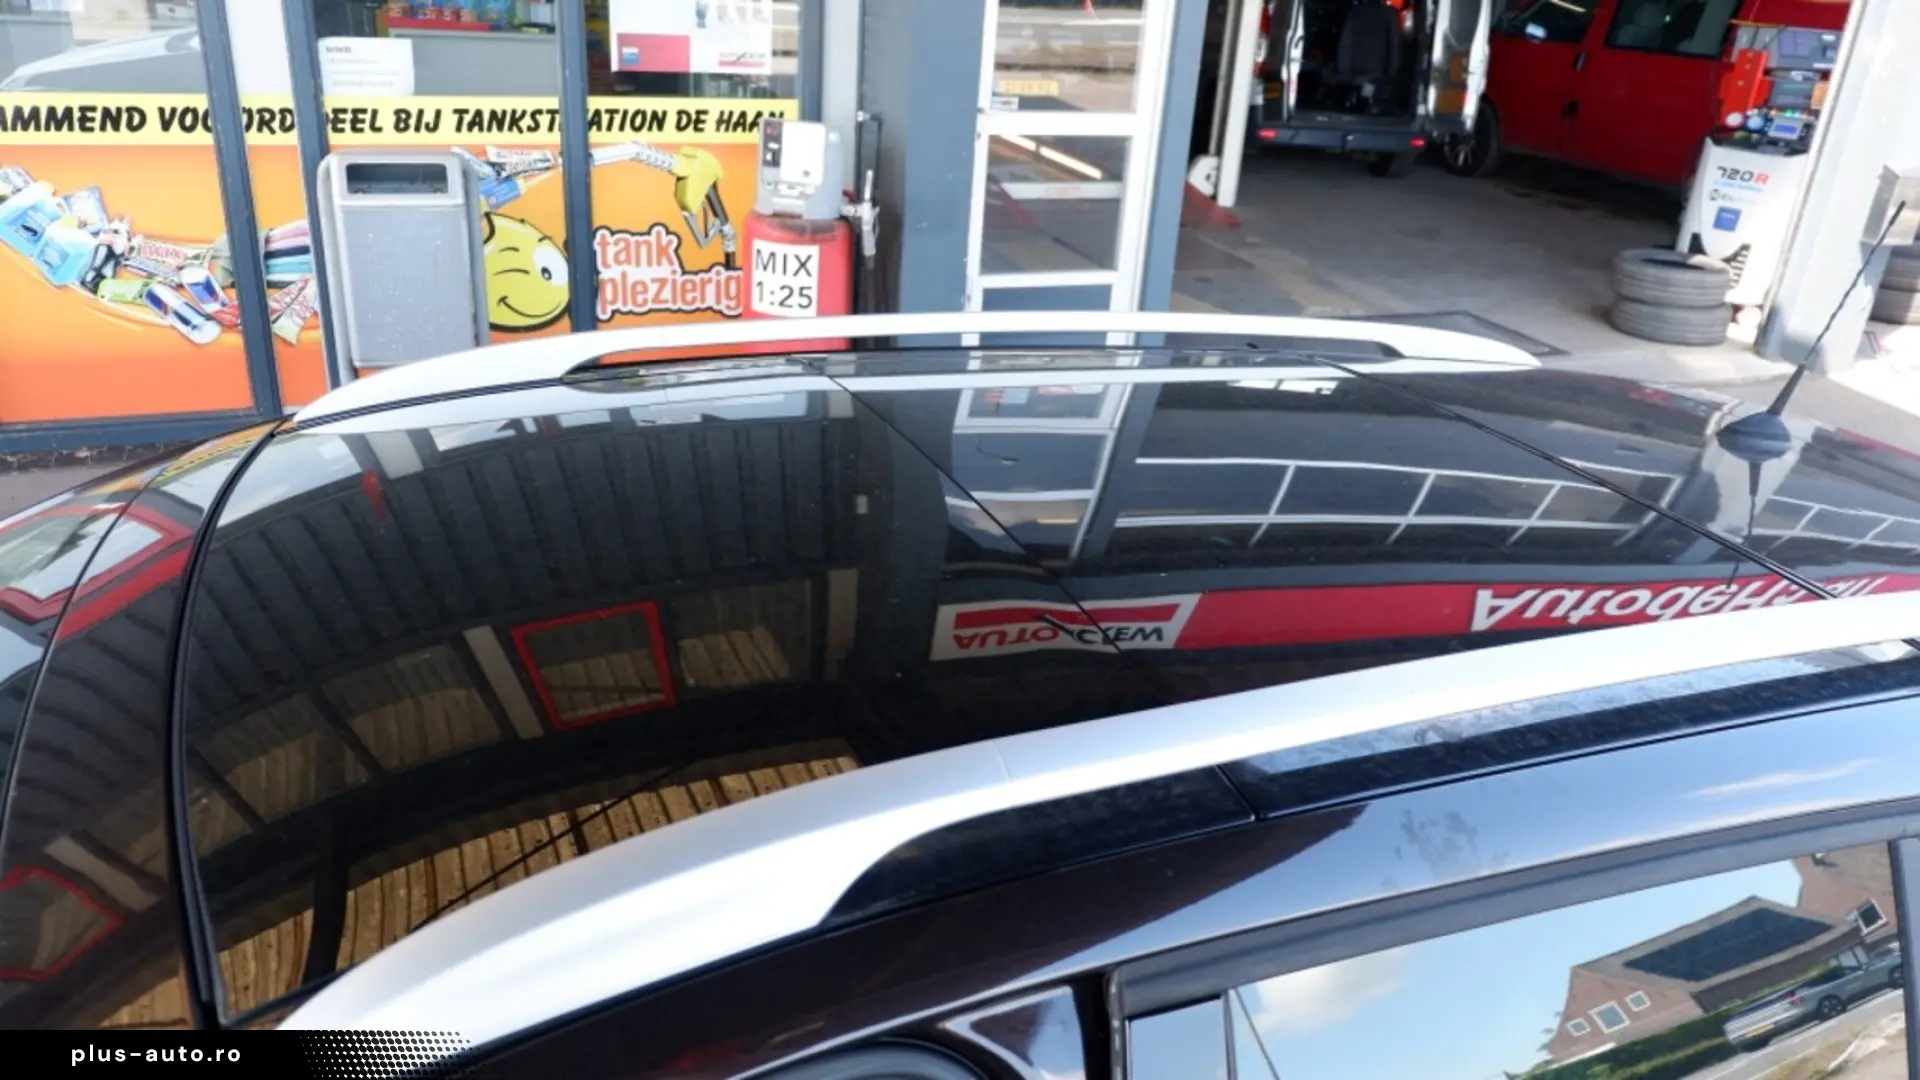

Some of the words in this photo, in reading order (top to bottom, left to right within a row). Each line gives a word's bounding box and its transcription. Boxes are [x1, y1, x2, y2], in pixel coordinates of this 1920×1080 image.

[393, 107, 442, 133] BIJ
[675, 109, 709, 133] DE
[1716, 165, 1769, 186] 720R
[597, 229, 676, 268] tank
[755, 248, 813, 277] MIX
[598, 268, 742, 315] plezierig
[756, 281, 813, 309] 1:25
